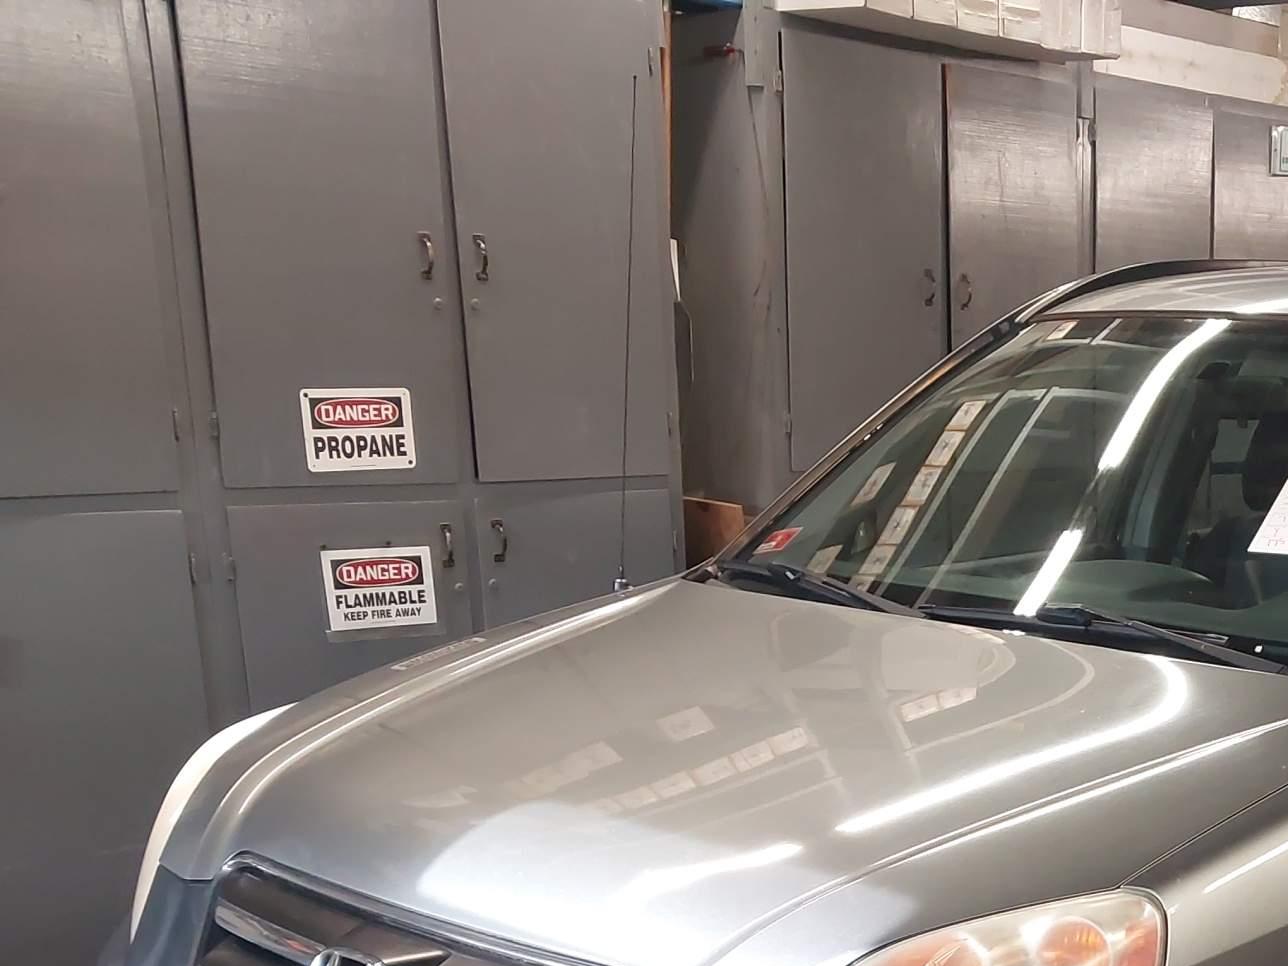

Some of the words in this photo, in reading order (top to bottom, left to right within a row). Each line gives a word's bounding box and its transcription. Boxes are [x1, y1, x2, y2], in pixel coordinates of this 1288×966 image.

[320, 404, 394, 422] DANGER
[313, 434, 408, 459] PROPANE
[342, 564, 414, 582] DANGER
[335, 590, 427, 610] FLAMMABLE
[344, 611, 369, 622] KEEP
[371, 609, 392, 620] FIRE
[395, 607, 422, 618] AWAY
